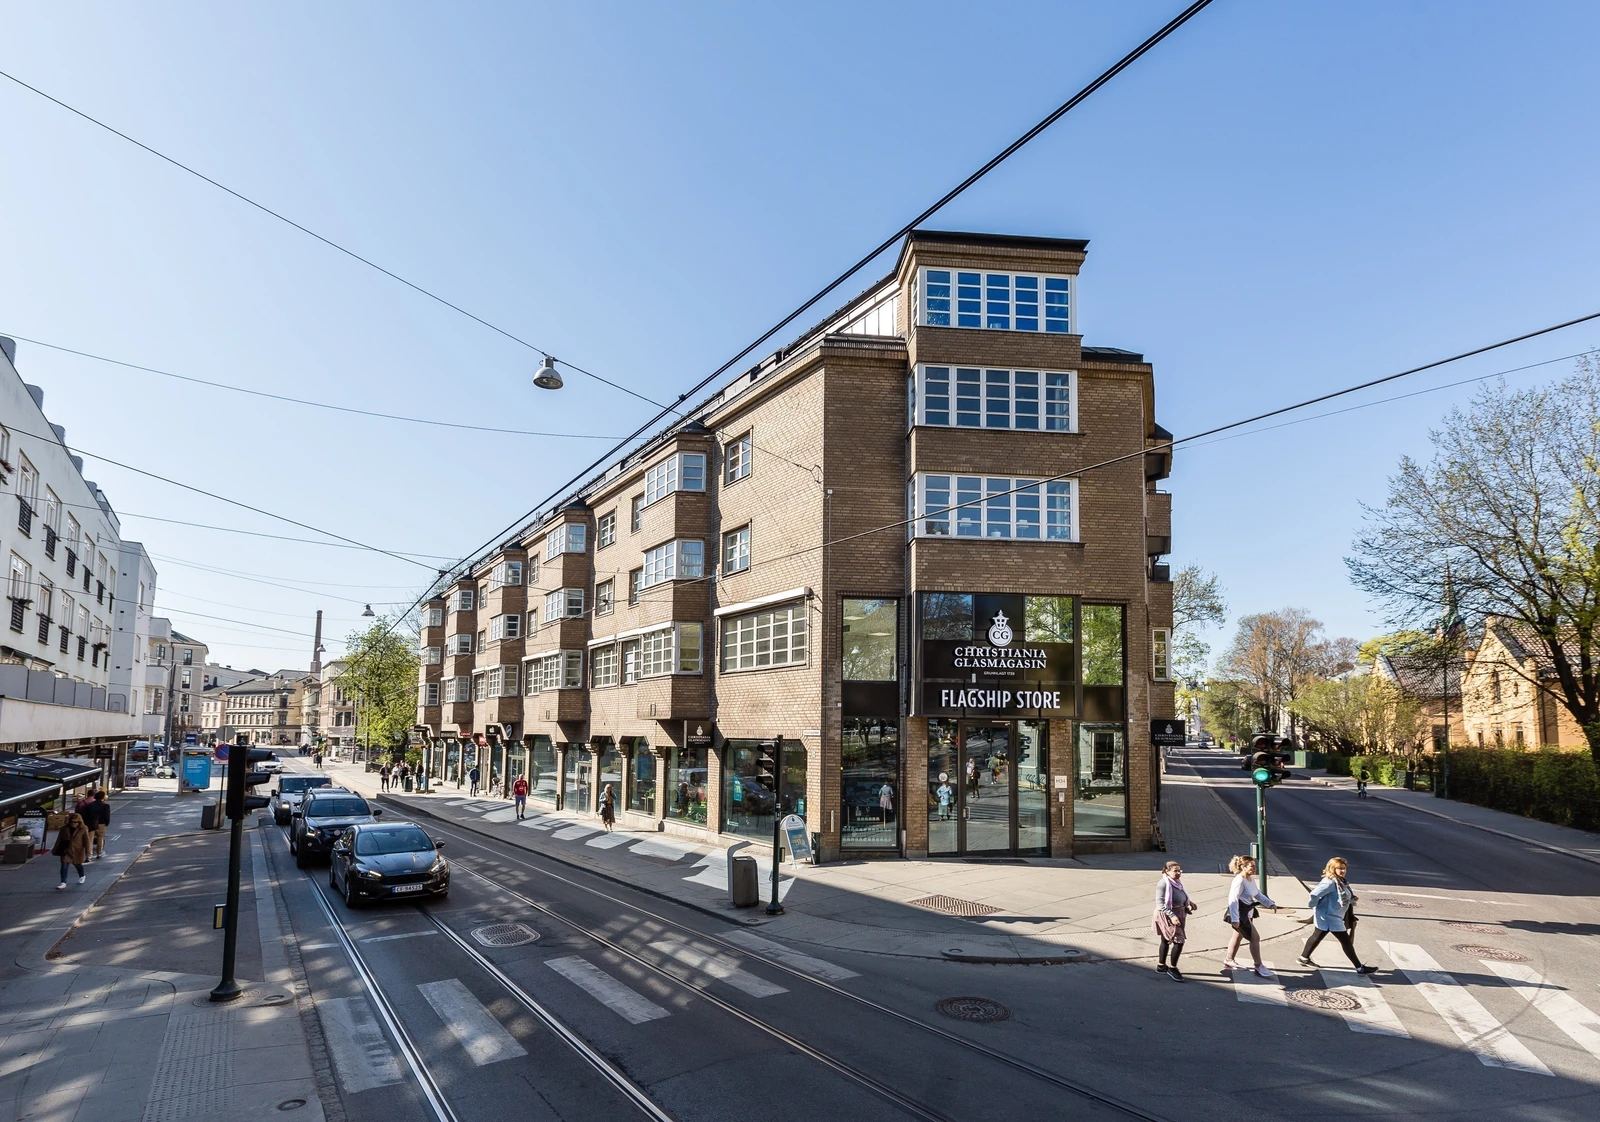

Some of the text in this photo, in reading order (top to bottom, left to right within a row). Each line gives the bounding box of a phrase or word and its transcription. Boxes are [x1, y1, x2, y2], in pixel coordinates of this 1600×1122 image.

[992, 630, 1009, 640] CG
[954, 647, 1047, 659] CHRISTIANIA
[954, 658, 1047, 669] GLASMAGASIN
[941, 689, 1061, 709] FLAGSHIP STORE
